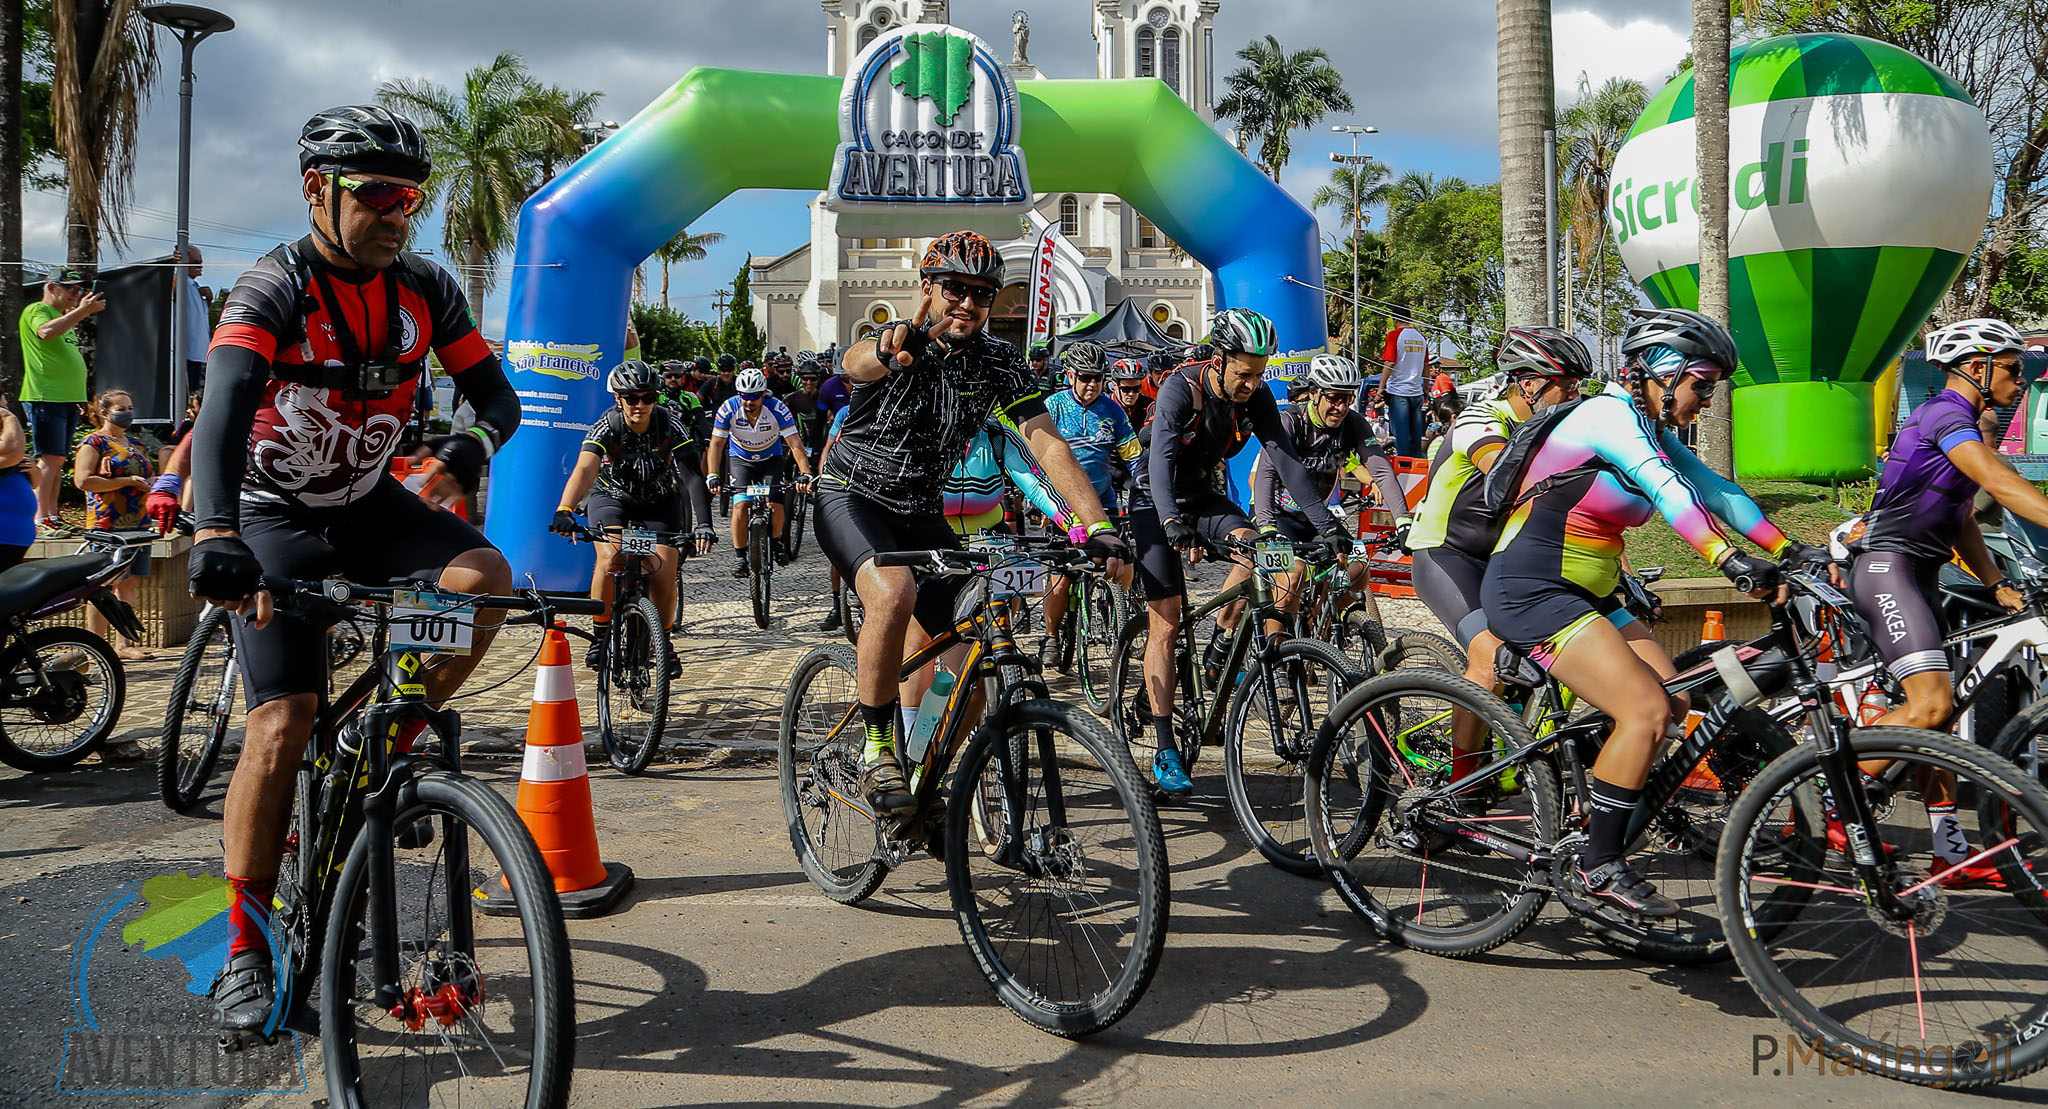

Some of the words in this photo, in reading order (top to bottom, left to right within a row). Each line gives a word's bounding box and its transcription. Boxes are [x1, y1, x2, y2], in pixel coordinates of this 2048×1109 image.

[881, 129, 984, 150] CACONDE
[844, 152, 1020, 197] AVENTURA
[1035, 235, 1056, 333] KENDA
[514, 354, 537, 374] São
[537, 352, 600, 380] Francisco
[1283, 361, 1312, 378] Fran
[1265, 553, 1289, 568] 030
[1003, 569, 1035, 590] 217
[410, 616, 458, 643] 001
[1874, 593, 1907, 644] ARKEA
